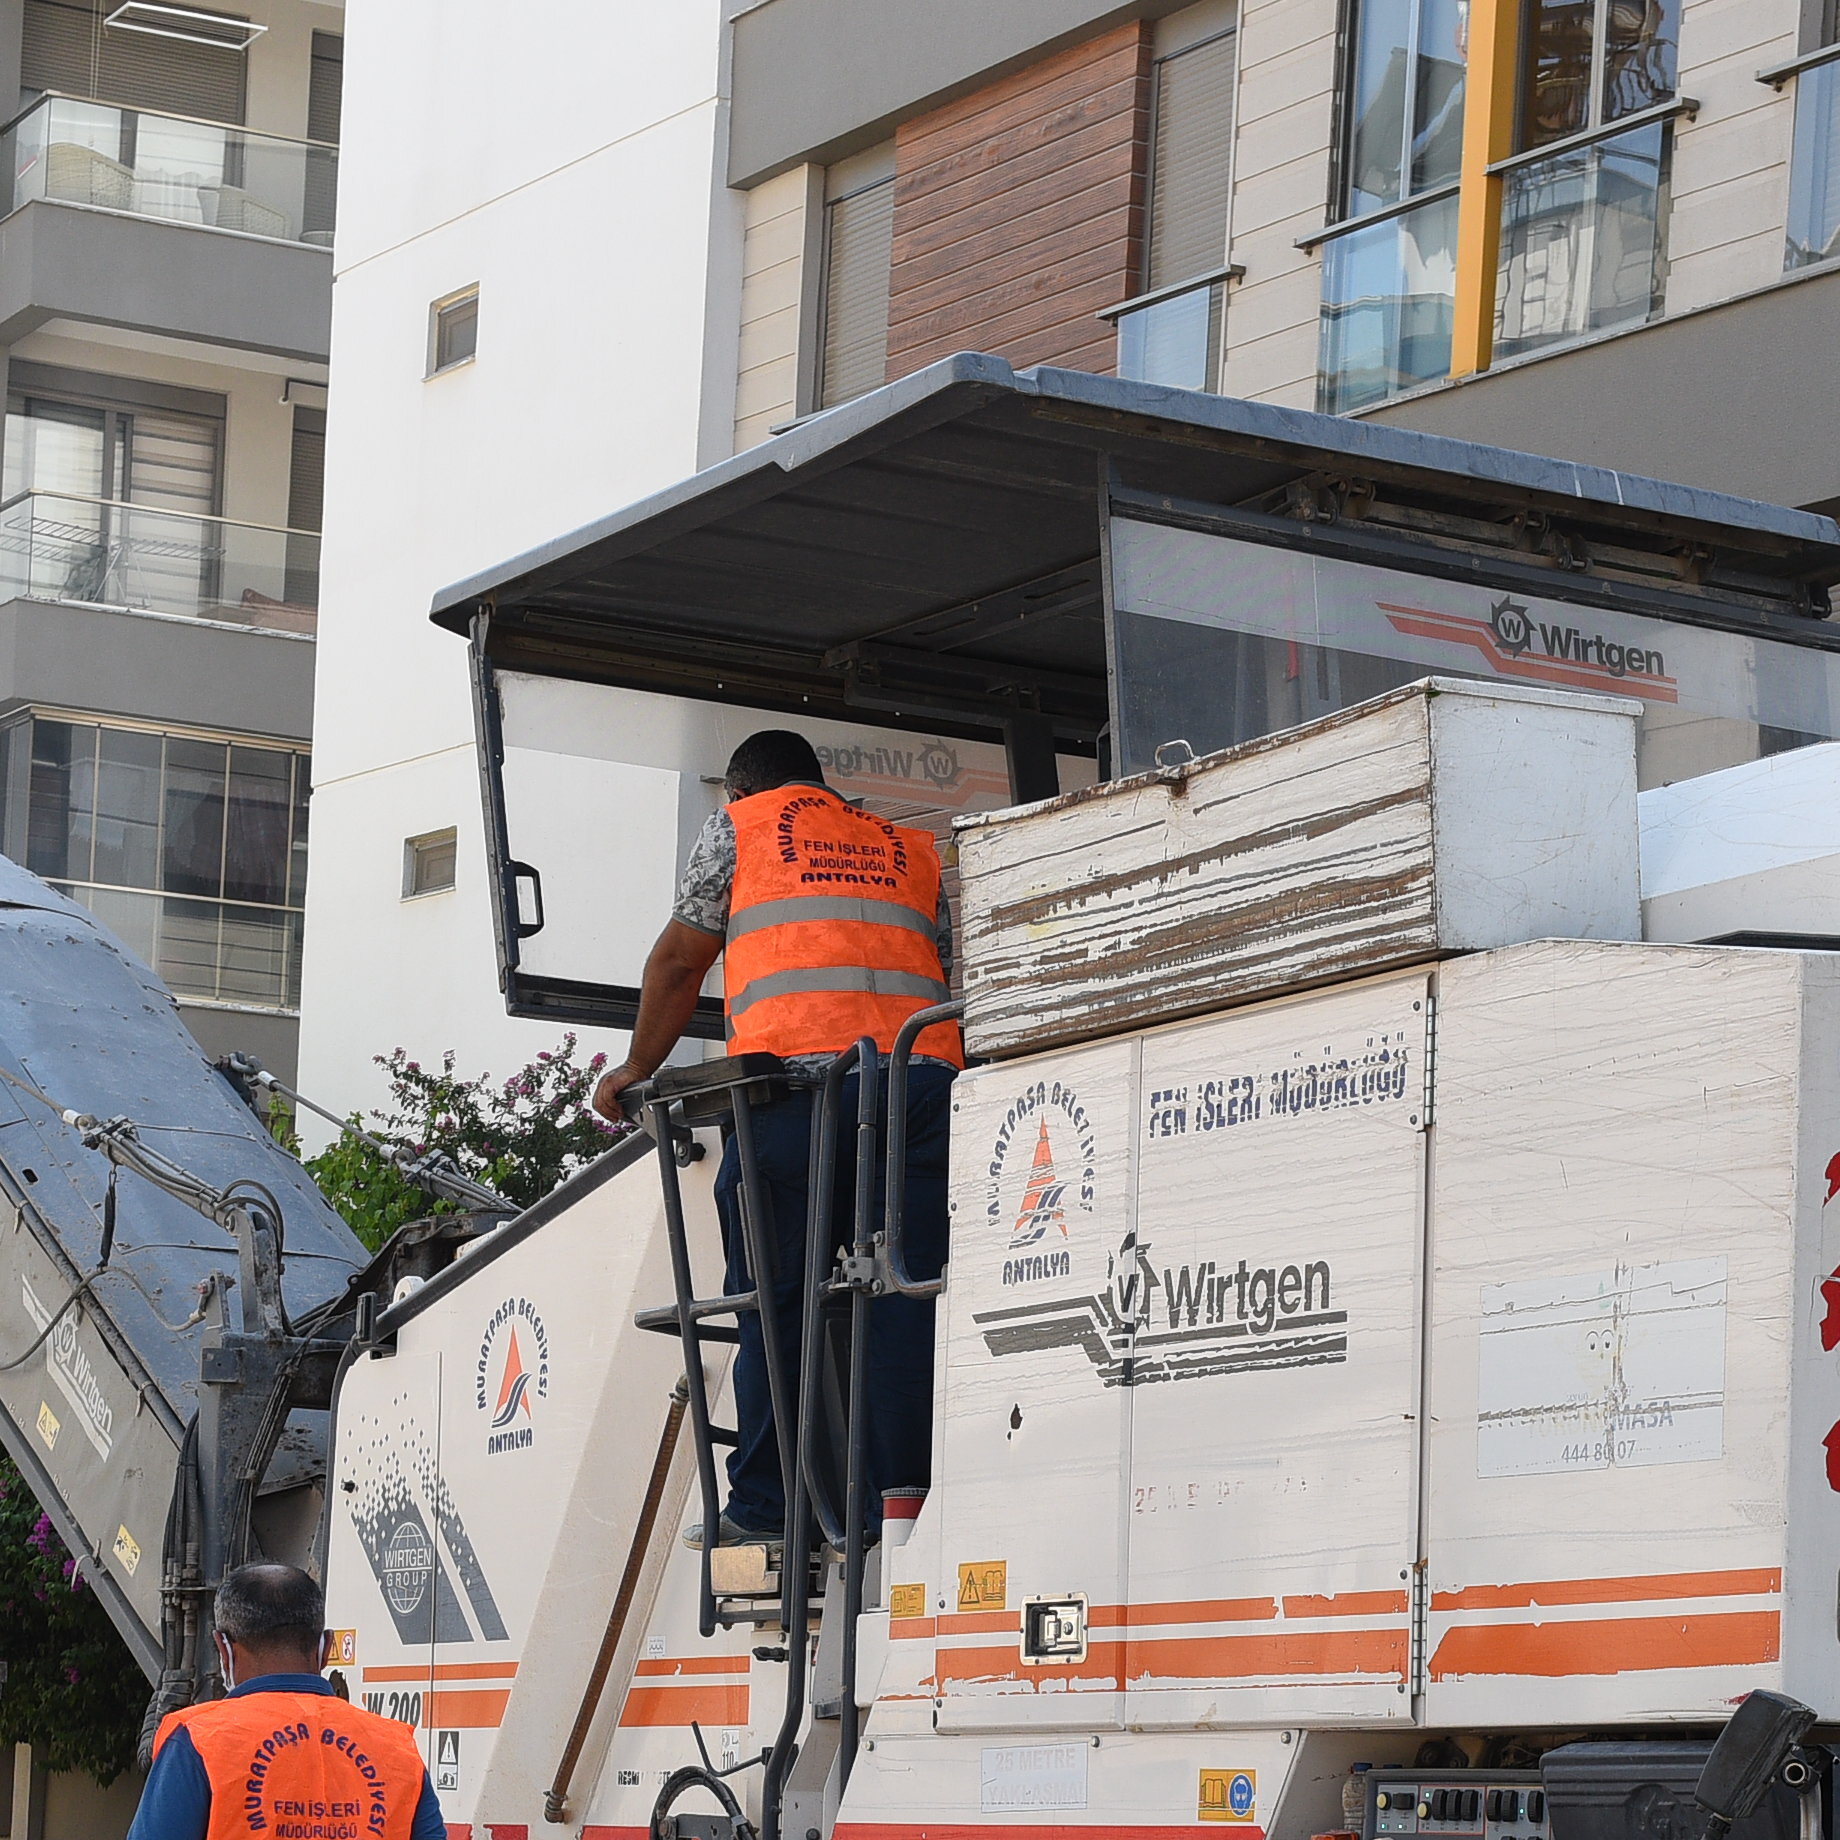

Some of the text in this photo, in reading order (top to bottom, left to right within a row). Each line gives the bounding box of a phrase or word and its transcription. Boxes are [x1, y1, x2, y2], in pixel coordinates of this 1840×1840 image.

[1538, 622, 1665, 678] Wirtgen
[803, 839, 886, 858] FEN İŞLERİ
[809, 855, 886, 873] MÜDÜRLÜĞÜ
[800, 872, 897, 889] ANTALYA
[1002, 1250, 1071, 1288] ANTALYA
[1163, 1259, 1331, 1336] Wirtgen
[476, 1297, 549, 1410] MURATPAŞA BELEDİYESİ
[72, 1345, 114, 1434] Wirtgen
[487, 1427, 533, 1455] ANTALYA
[1561, 1442, 1589, 1463] 444
[1617, 1439, 1636, 1459] 07
[384, 1547, 433, 1569] WIRTGEN
[386, 1570, 428, 1587] GROUP
[388, 1691, 421, 1729] 200
[244, 1722, 310, 1831] MURATPAŞA
[274, 1800, 305, 1816] FEN
[275, 1822, 358, 1840] MÜDÜRLÜĞÜ
